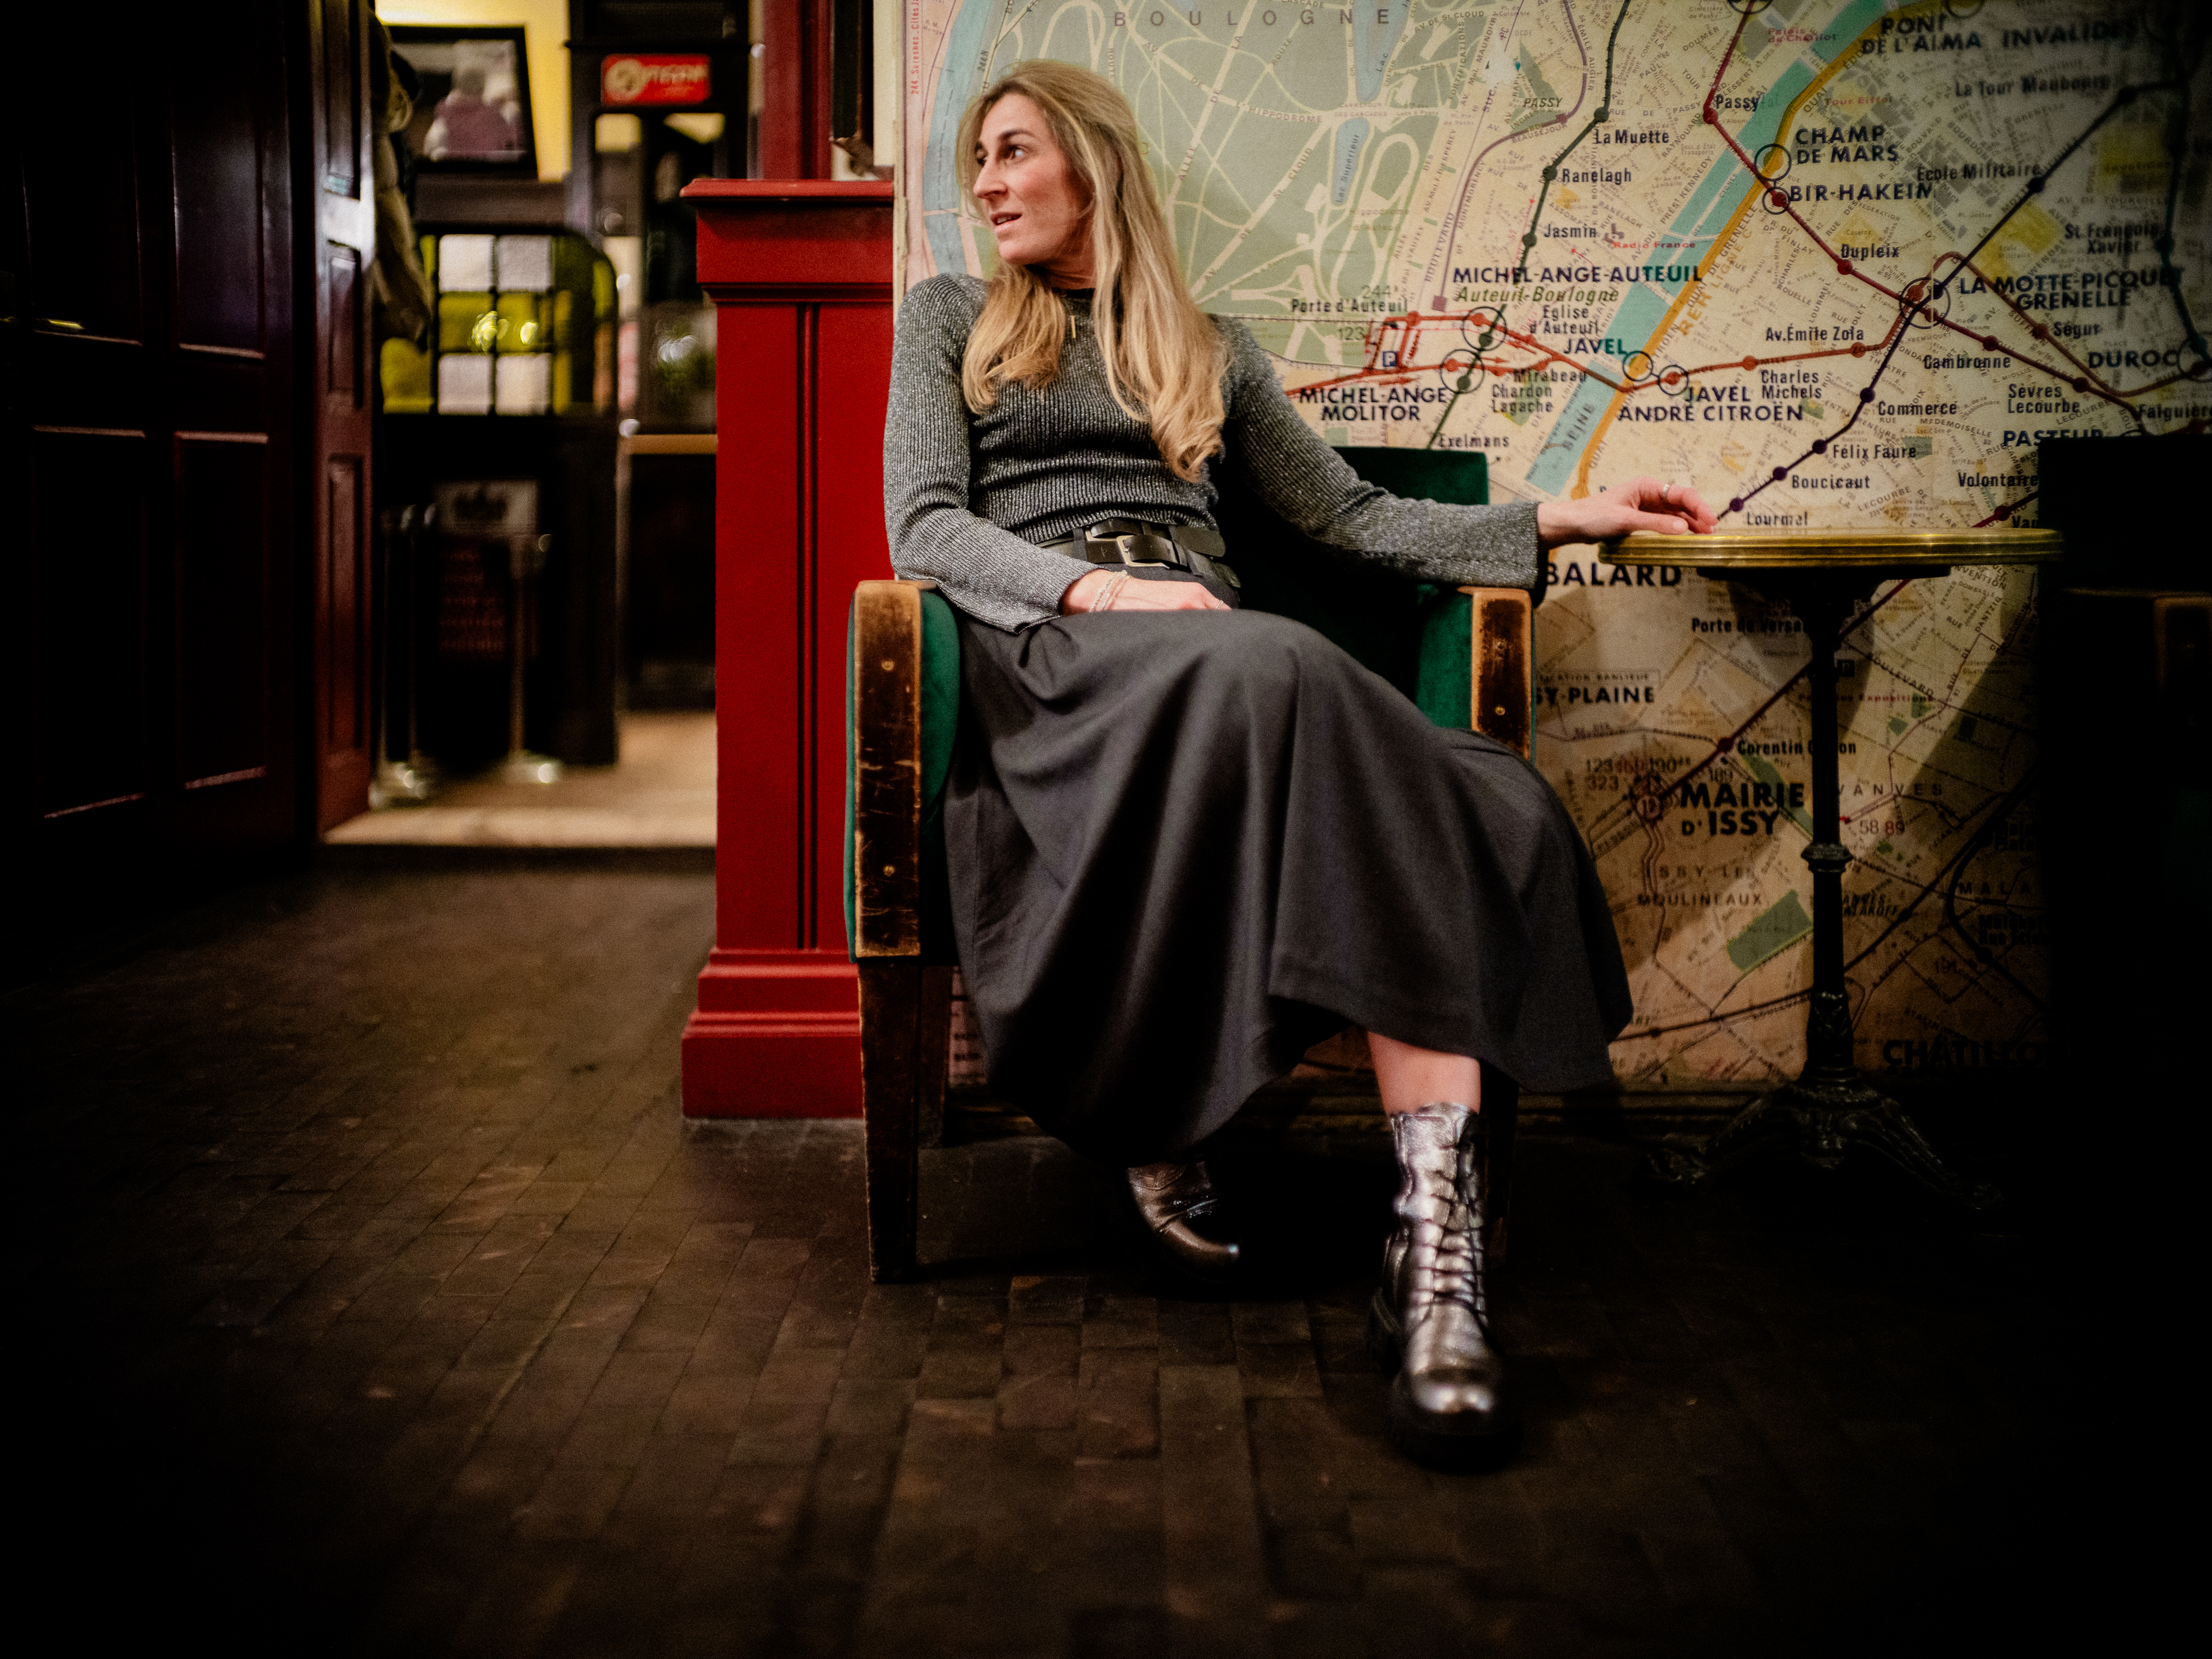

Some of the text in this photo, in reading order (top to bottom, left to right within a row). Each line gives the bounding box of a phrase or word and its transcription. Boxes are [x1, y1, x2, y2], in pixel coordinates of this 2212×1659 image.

[1114, 9, 1390, 28] BOULOGNE
[1454, 10, 1485, 19] CLOUD
[1881, 13, 1948, 35] PONT
[1682, 26, 1720, 52] DOUMER
[1863, 38, 1887, 55] DE
[1652, 71, 1670, 96] NICOLO
[1681, 68, 1701, 90] TOUR
[1522, 97, 1564, 109] PASSY
[1672, 101, 1701, 114] PASSY
[1715, 94, 1759, 112] Passy
[1802, 87, 1828, 114] QUAI
[1595, 128, 1670, 145] La Muette
[1660, 112, 1702, 159] RAYNOUARD
[1796, 126, 1887, 145] CHAMP
[1796, 144, 1899, 164] DE MARS
[1562, 166, 1633, 186] Ranelagh
[1679, 155, 1713, 199] KENNEDY
[1790, 183, 1935, 203] BIR-HAKEIM
[1543, 224, 1598, 239] Jasmin
[1719, 205, 1758, 258] GRENELLE
[1825, 220, 1842, 237] RUE
[1840, 243, 1900, 261] Dupleix
[2087, 238, 2142, 254] Xavier
[1453, 265, 1704, 284] MICHEL-ANGE-AUTEUIL
[1959, 277, 1990, 295] LA
[1456, 285, 1619, 307] Auteuil-Boulogne
[2015, 288, 2134, 312] GRENELLE
[1290, 298, 1332, 313] Porte
[1832, 325, 1865, 341] Zola
[1562, 337, 1627, 355] JAVEL
[1923, 354, 2012, 370] Cambronne
[2087, 348, 2179, 369] DUROC
[1761, 369, 1820, 384] Charles
[1299, 387, 1447, 404] MICHEL-ANGE
[1491, 383, 1552, 399] Chardon
[1684, 386, 1751, 403] JAVEL
[1761, 384, 1823, 400] Michels
[1321, 404, 1421, 422] MOLITOR
[1878, 399, 1958, 417] Commerce
[2007, 398, 2081, 415] Lecourbe
[1560, 402, 1596, 452] SEINE
[1919, 416, 1993, 438] MADEMOISELLE
[1437, 433, 1510, 449] Exelmans
[1833, 442, 1917, 460] Félix Faure
[1792, 474, 1871, 490] Boucicaut
[1547, 561, 1682, 587] BALARD
[1691, 616, 1732, 633] Porte
[1737, 738, 1803, 755] Corentin
[1679, 781, 1805, 808] MAIRIE
